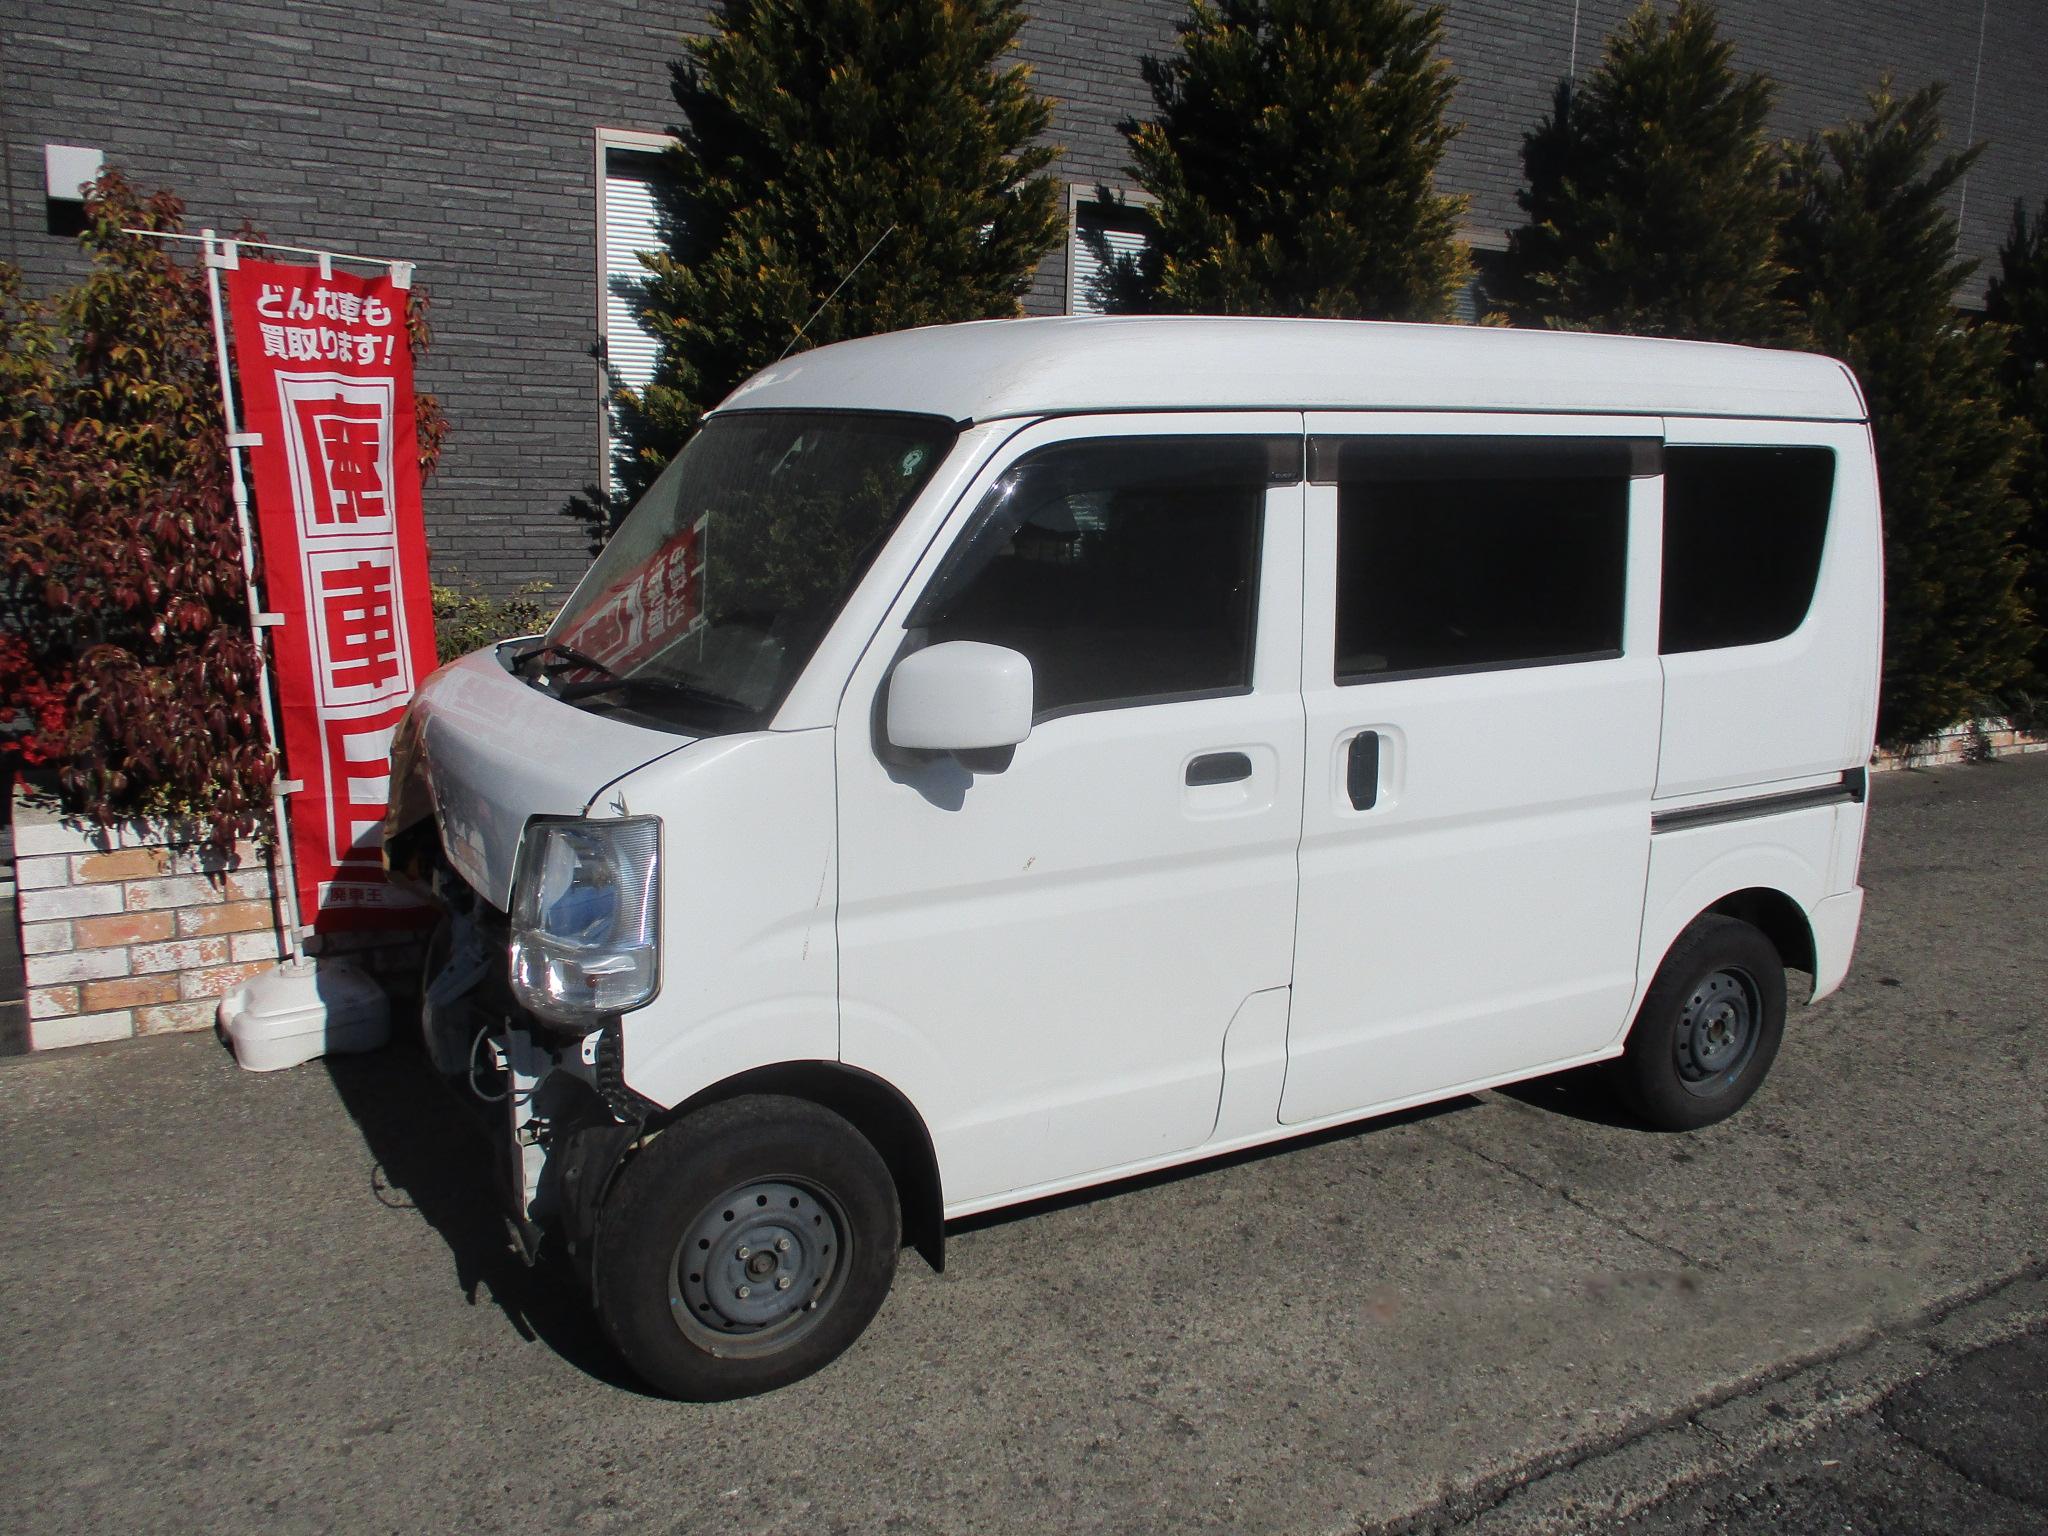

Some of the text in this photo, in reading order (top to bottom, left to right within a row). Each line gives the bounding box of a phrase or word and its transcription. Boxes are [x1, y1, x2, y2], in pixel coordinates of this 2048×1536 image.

[256, 283, 392, 326] どんな車も
